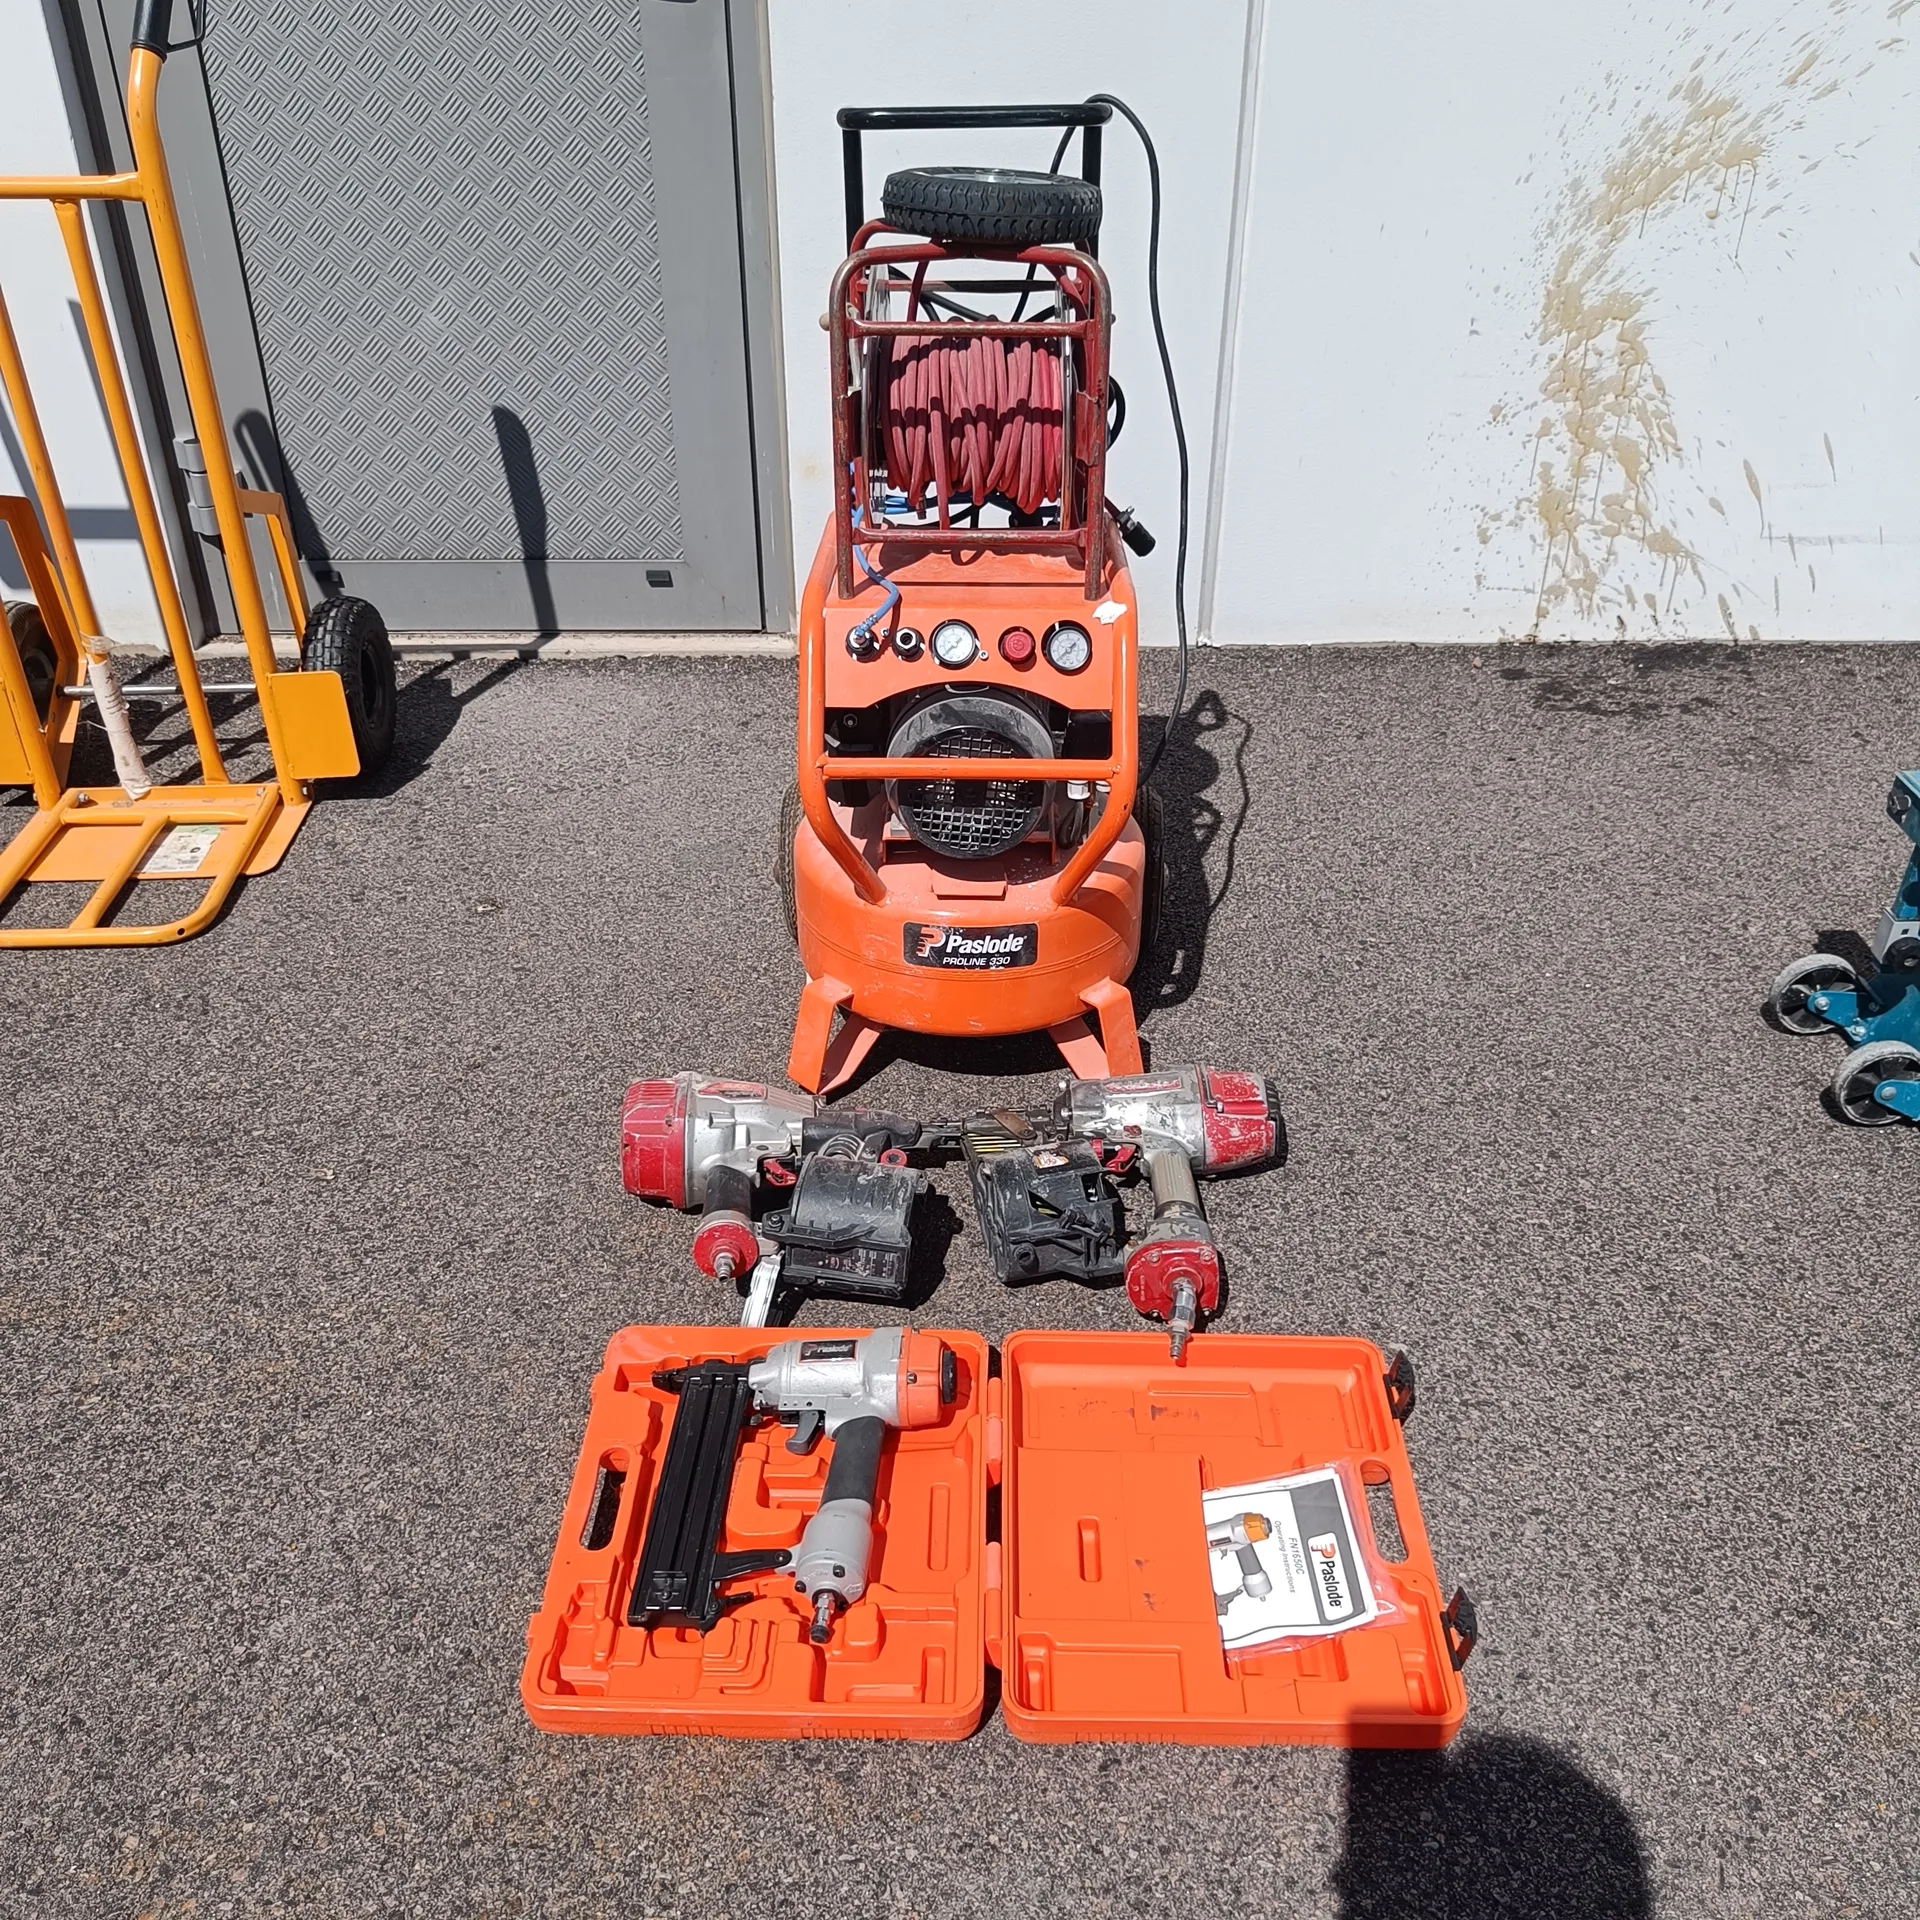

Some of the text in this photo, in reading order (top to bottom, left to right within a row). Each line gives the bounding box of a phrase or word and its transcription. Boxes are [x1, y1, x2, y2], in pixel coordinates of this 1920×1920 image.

[946, 934, 1024, 954] Paslode
[942, 956, 1011, 966] PROLINE 330
[1275, 1520, 1287, 1552] Operating
[1288, 1537, 1304, 1575] FN1650C
[1319, 1560, 1343, 1607] Paslode
